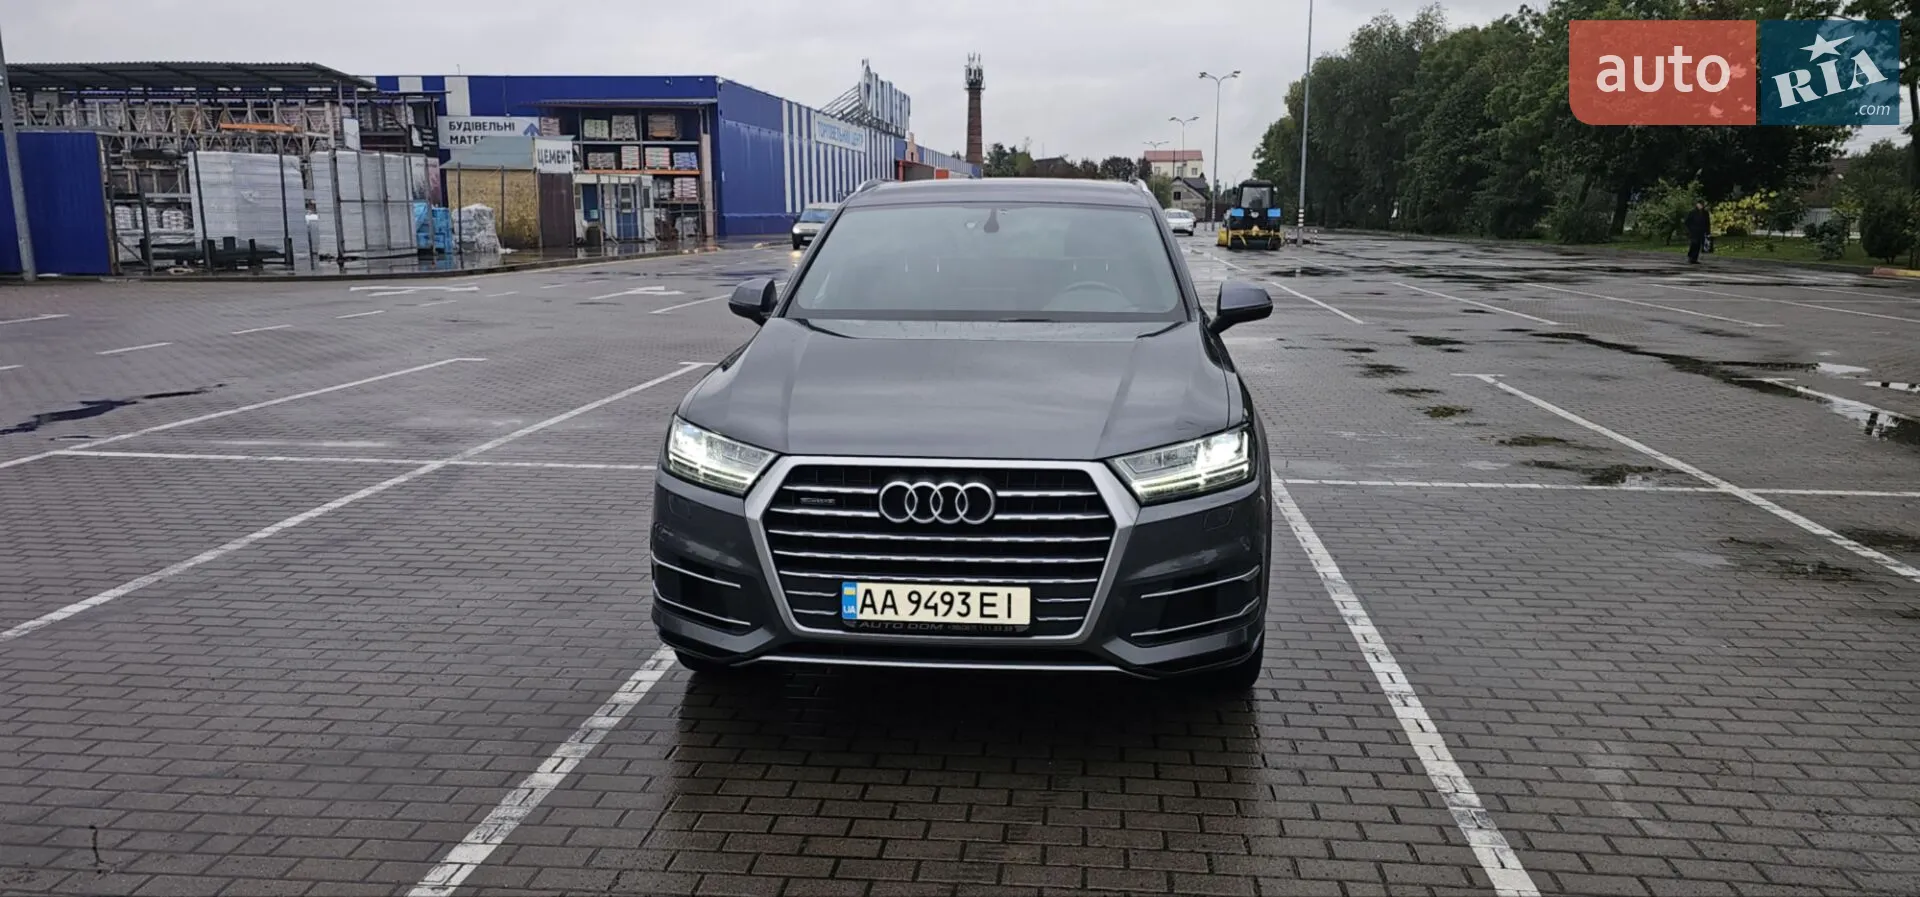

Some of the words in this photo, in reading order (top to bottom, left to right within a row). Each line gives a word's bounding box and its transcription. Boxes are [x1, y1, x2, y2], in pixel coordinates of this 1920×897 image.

[448, 121, 515, 132] БУДІВЕЛЬНІ
[537, 149, 571, 166] ЦЕМЕНТ
[907, 590, 971, 618] 9493
